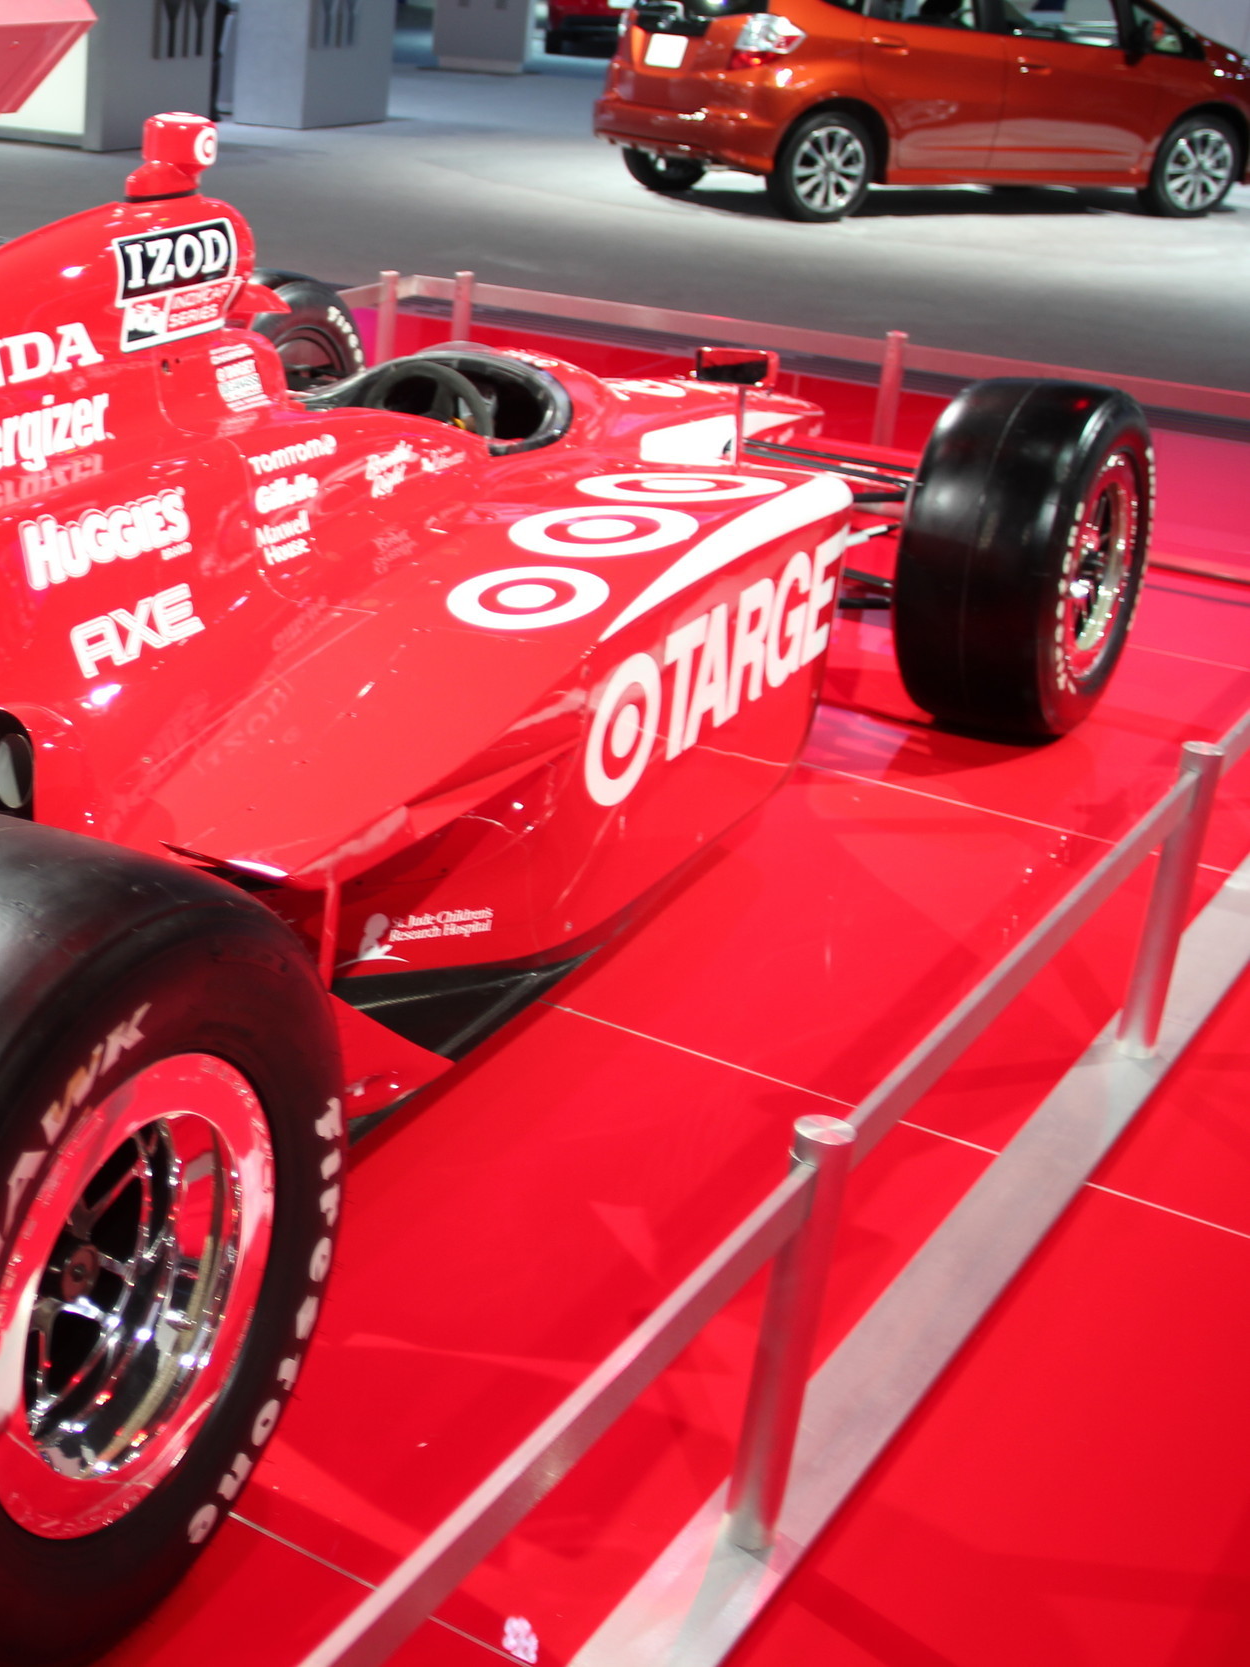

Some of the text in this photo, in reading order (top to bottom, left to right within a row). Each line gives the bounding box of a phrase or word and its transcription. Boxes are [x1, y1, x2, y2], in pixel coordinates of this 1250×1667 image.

[125, 228, 230, 288] IZOD
[168, 303, 219, 328] SERIES
[70, 582, 206, 679] AXE
[388, 919, 493, 942] Research Hospital
